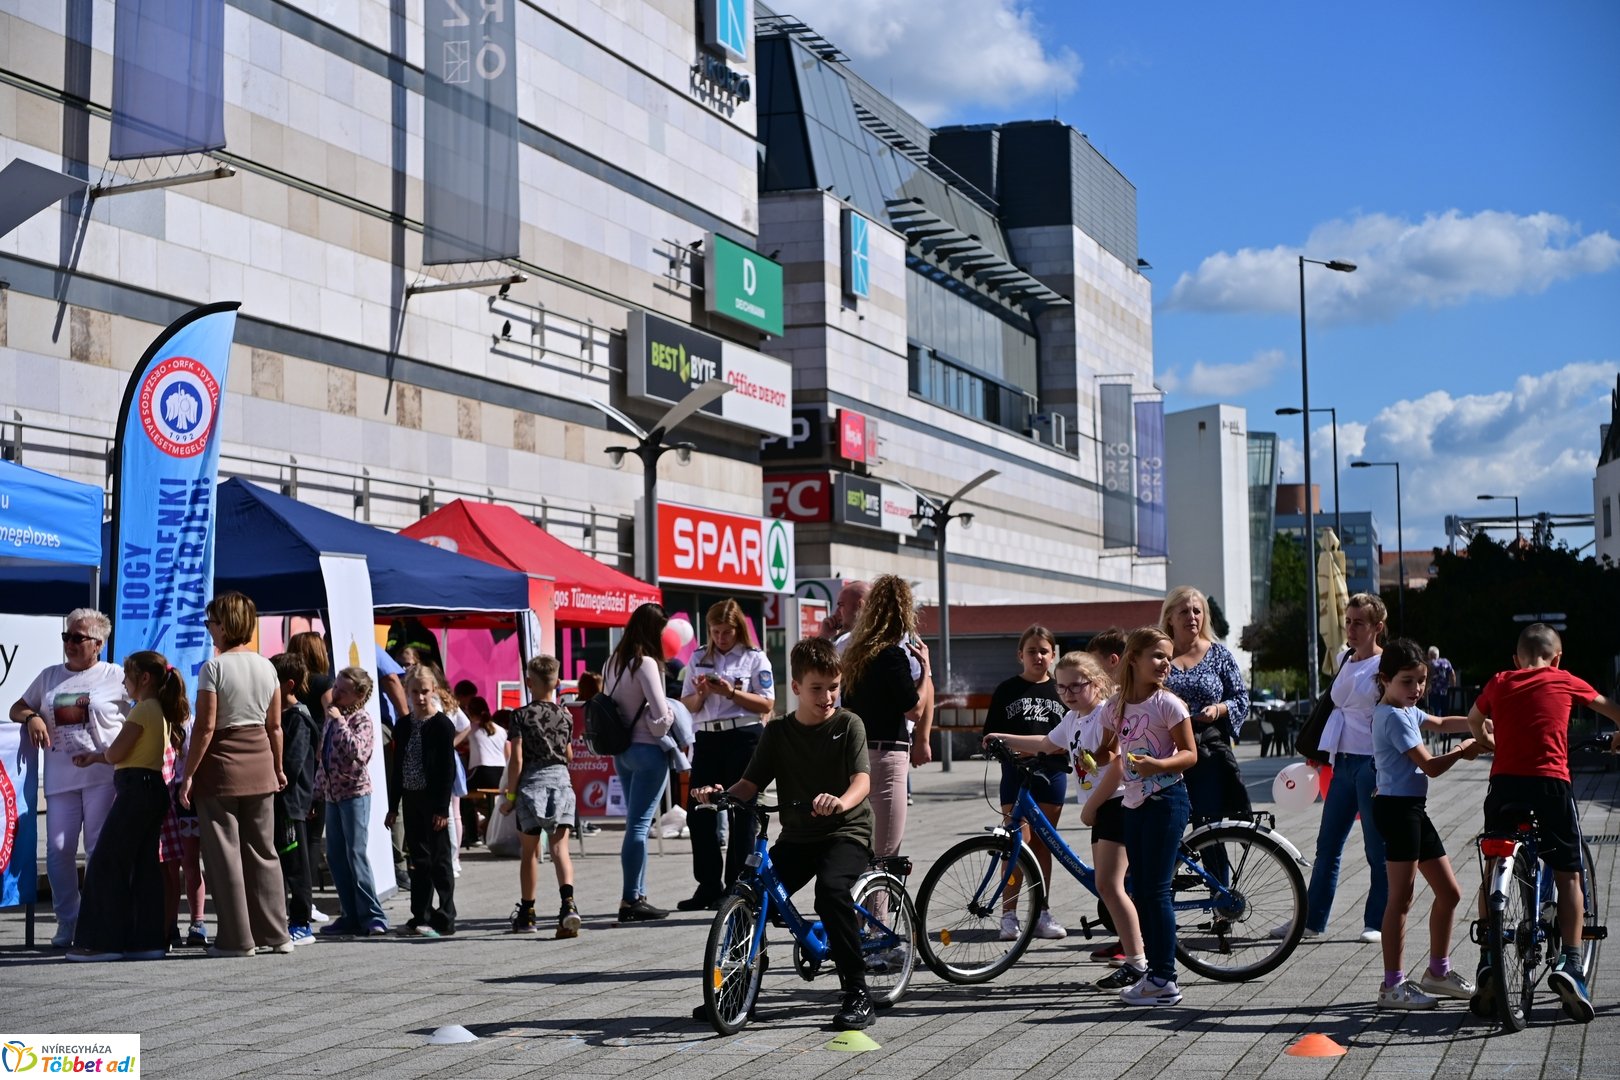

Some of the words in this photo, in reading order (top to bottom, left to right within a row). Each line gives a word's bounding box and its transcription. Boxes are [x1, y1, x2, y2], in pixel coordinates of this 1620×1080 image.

[172, 359, 196, 371] ORFK
[651, 341, 679, 373] BEST
[690, 354, 716, 381] BYTE
[141, 364, 168, 416] ORSZÁGOS
[727, 370, 758, 400] Office
[758, 384, 787, 408] DEPOT
[168, 431, 194, 443] 1992
[763, 479, 822, 516] FC
[151, 477, 188, 619] MINDENKI
[673, 516, 762, 577] SPAR
[121, 541, 152, 621] HOGY
[1005, 697, 1033, 720] NEW
